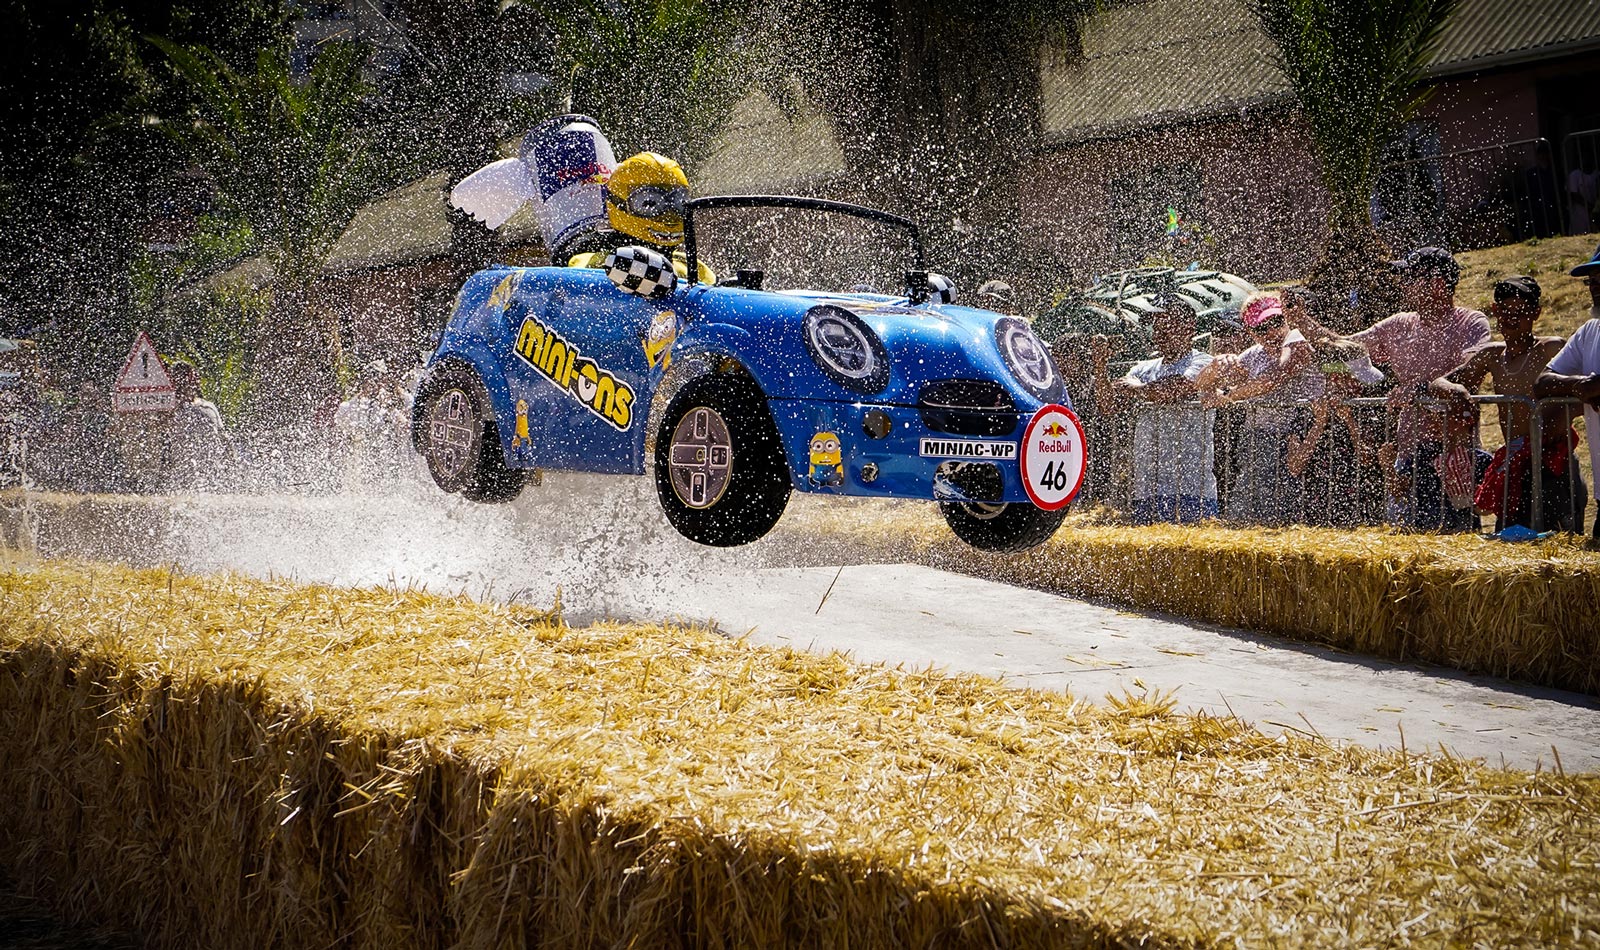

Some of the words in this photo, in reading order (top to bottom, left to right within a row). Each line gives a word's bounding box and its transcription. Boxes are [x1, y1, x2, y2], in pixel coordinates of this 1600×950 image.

[924, 441, 1014, 457] MINIAC-WP
[1039, 440, 1056, 453] Red
[1056, 440, 1072, 453] Bull
[1040, 460, 1067, 491] 46
